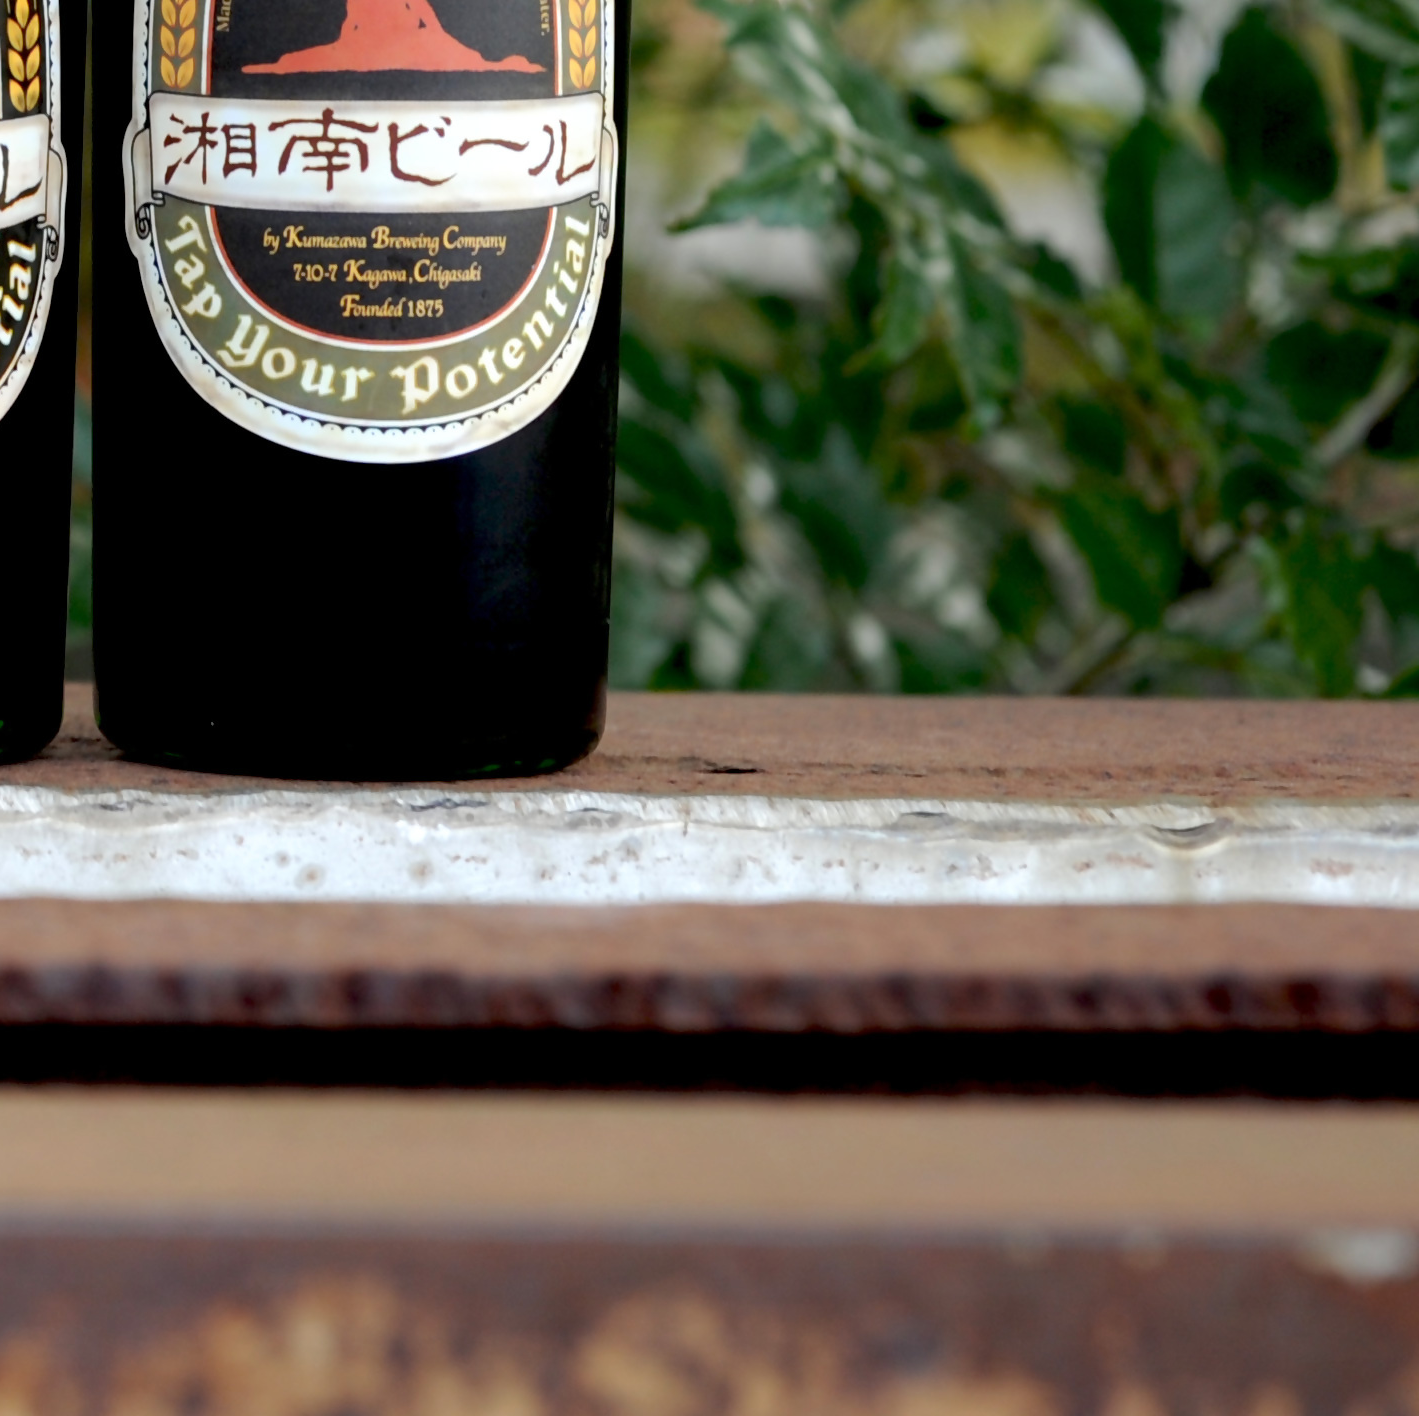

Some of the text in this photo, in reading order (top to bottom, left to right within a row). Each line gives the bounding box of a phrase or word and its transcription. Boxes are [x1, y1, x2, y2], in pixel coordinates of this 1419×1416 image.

[164, 108, 596, 192] 湘南ビール
[263, 228, 280, 254] by
[283, 225, 367, 248] Kumazawa
[443, 226, 506, 255] Company
[293, 264, 338, 281] 7-10-7
[414, 259, 481, 289] Chigasaki
[165, 215, 590, 415] Tap Your Potential
[340, 295, 444, 317] Founded 1875
